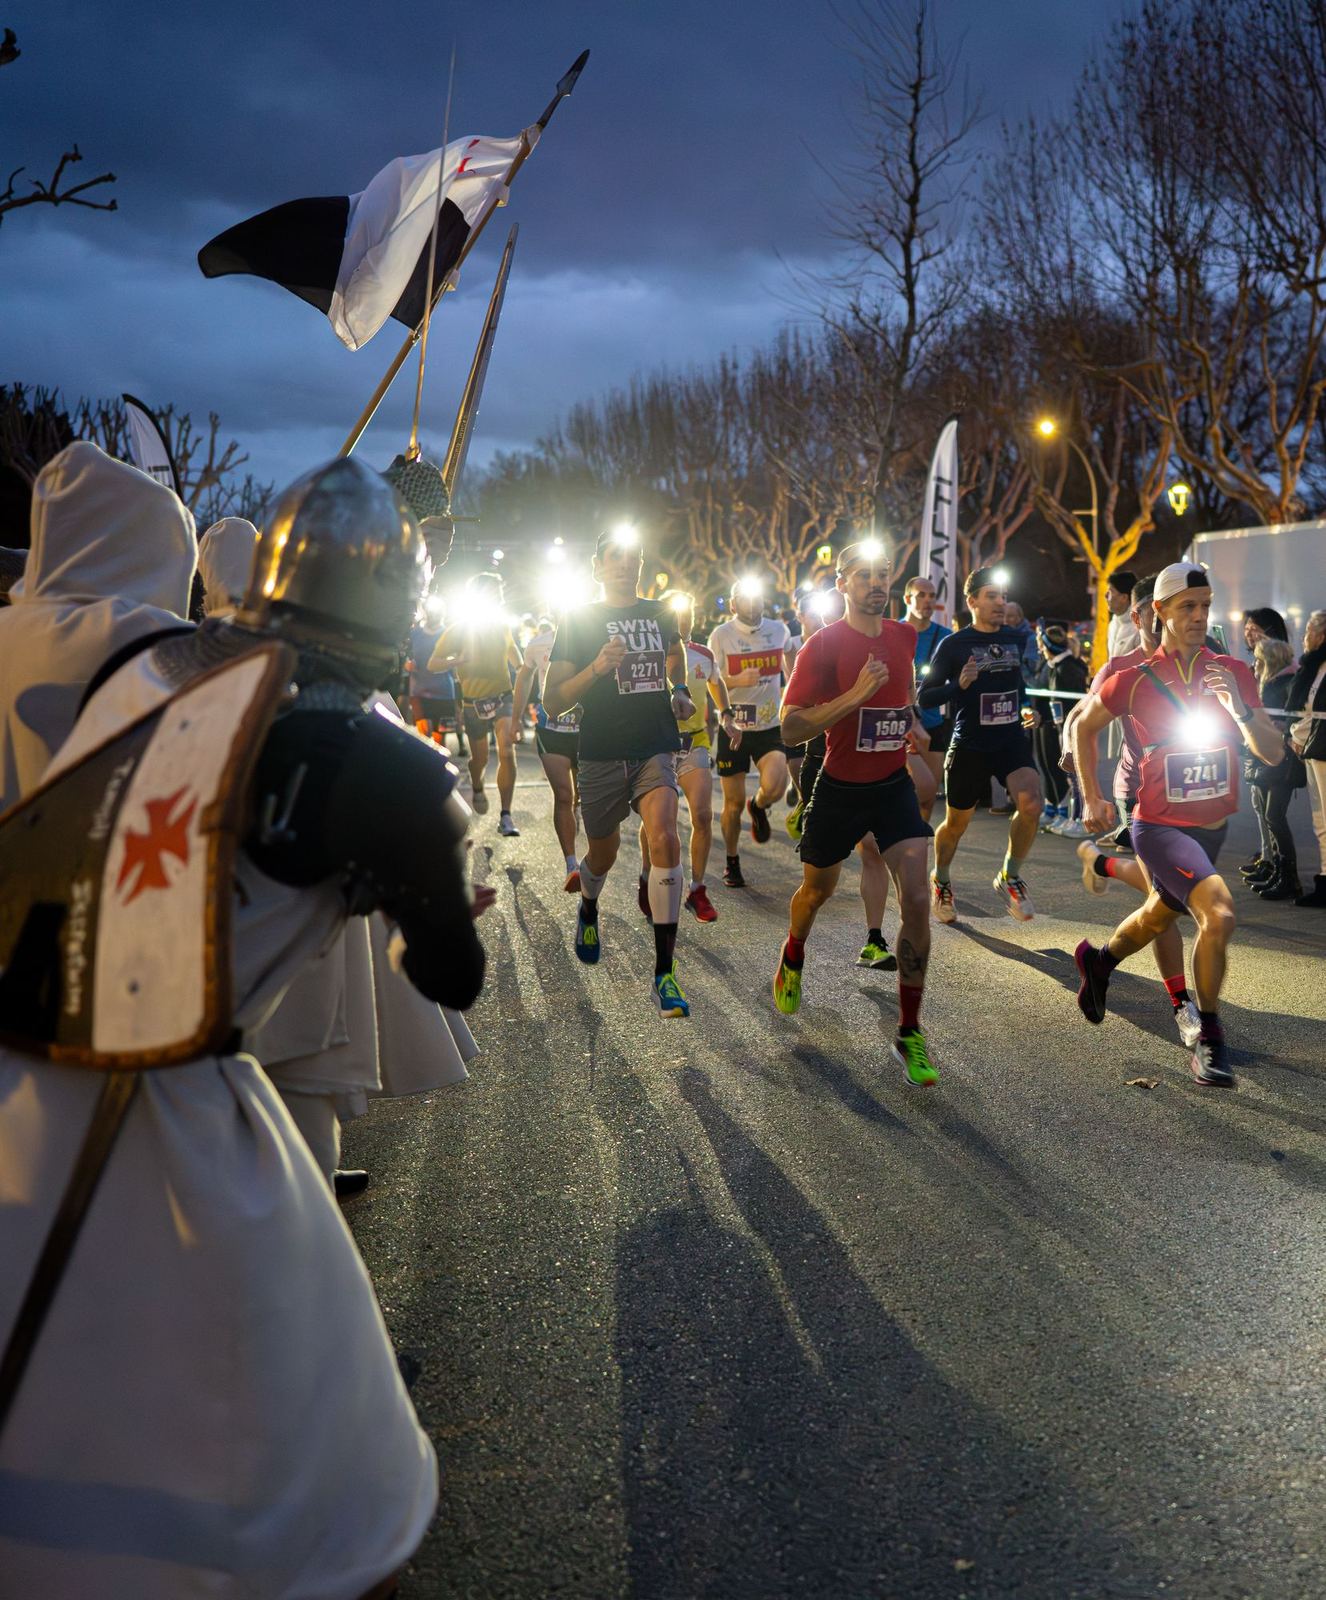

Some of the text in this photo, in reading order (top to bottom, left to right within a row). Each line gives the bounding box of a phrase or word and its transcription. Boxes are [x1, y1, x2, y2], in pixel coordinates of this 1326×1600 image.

[606, 619, 659, 634] SWIM
[631, 662, 658, 678] 2271
[875, 720, 906, 736] 1508
[1183, 764, 1217, 784] 2741
